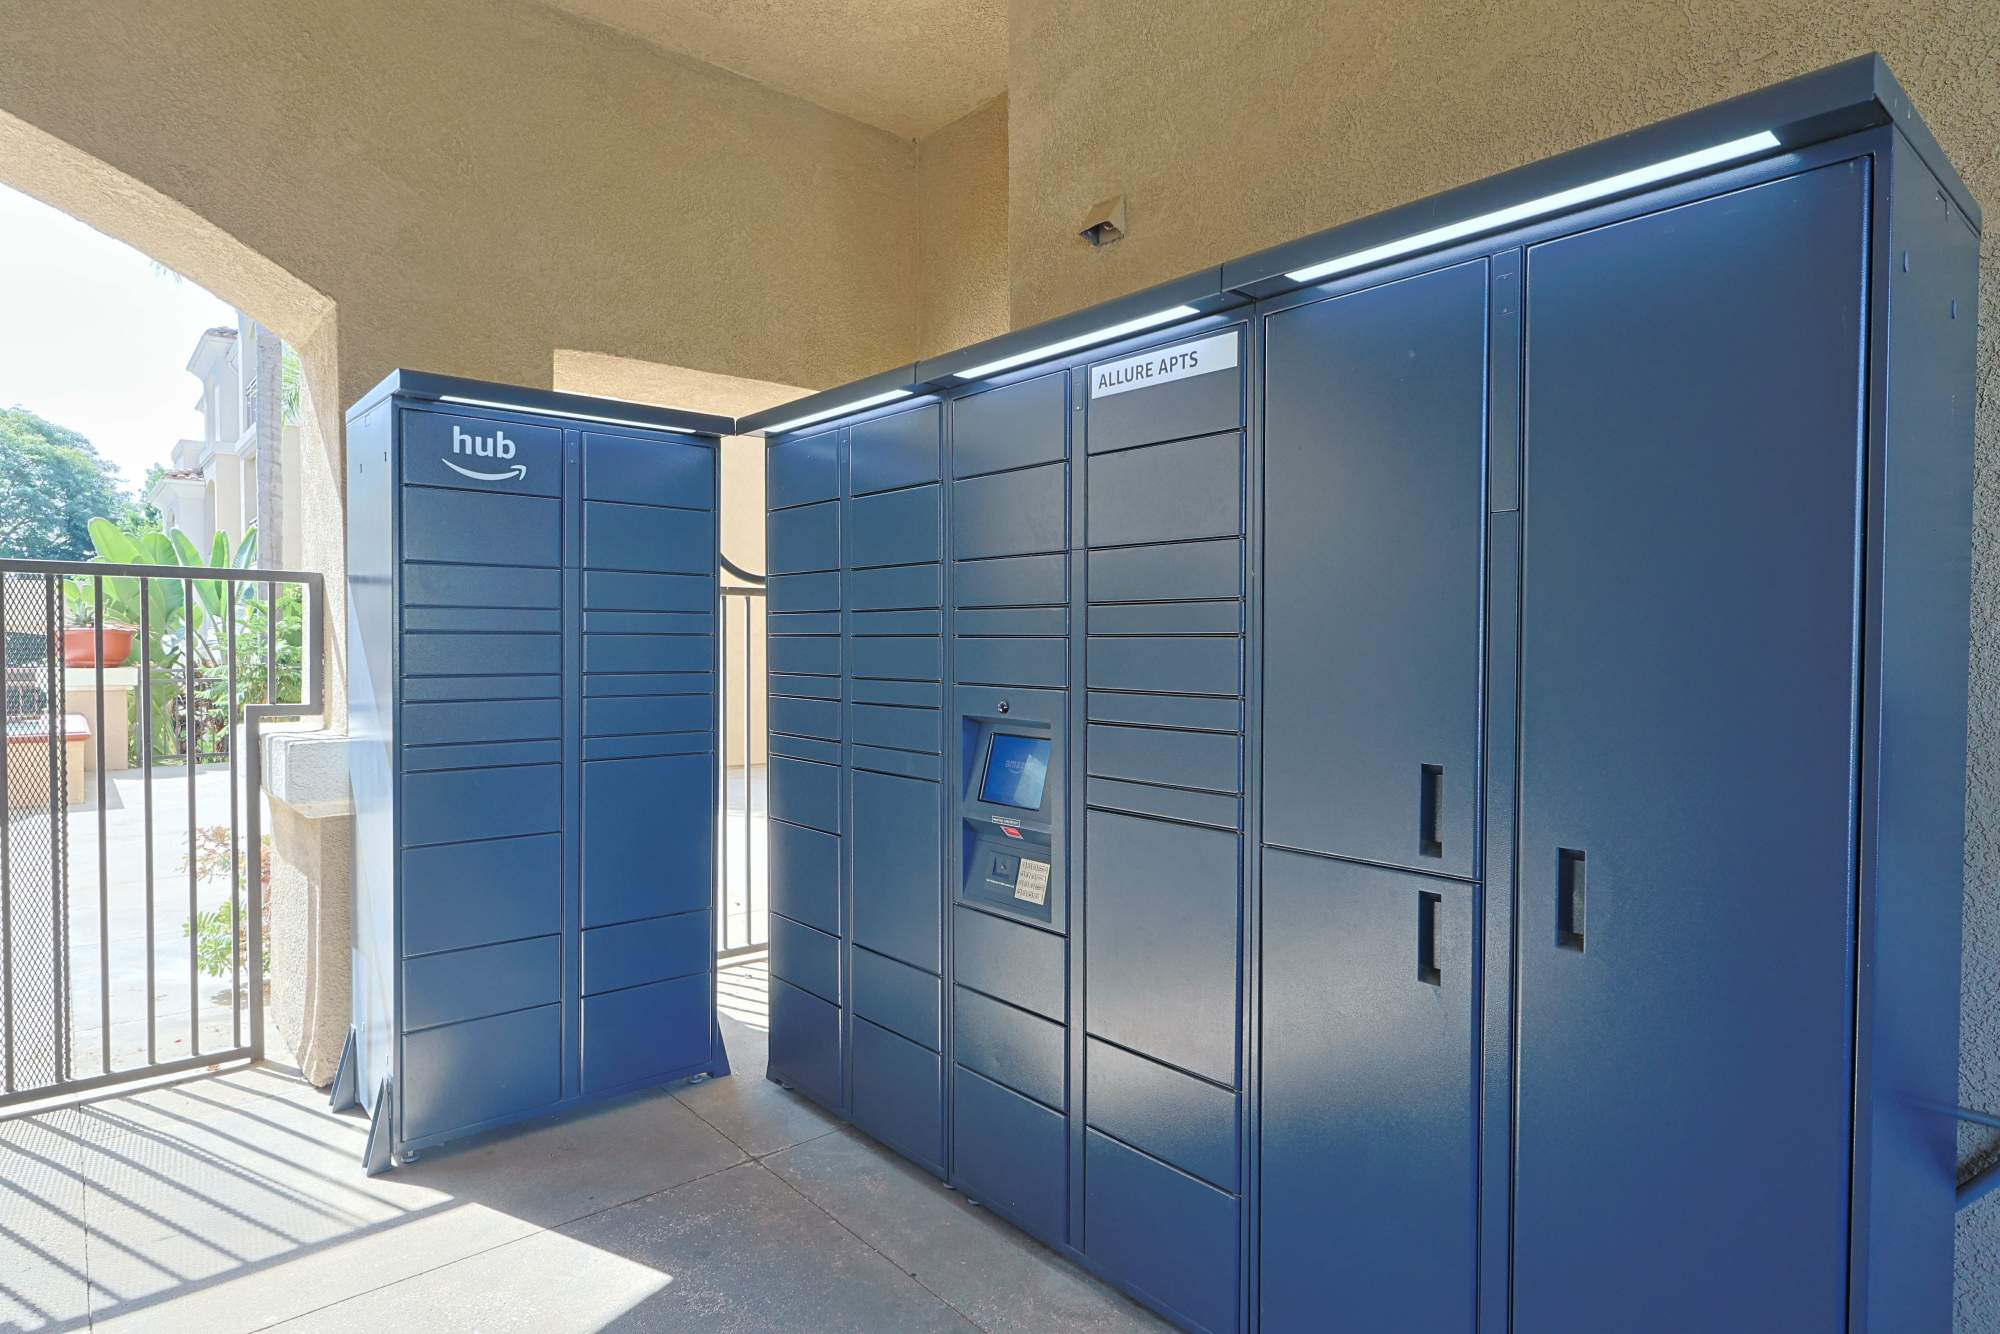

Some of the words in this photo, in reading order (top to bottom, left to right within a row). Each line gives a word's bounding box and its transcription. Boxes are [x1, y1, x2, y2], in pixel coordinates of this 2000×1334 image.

[1098, 361, 1154, 389] ALLURE
[1158, 350, 1199, 375] APTS
[452, 425, 516, 460] hub
